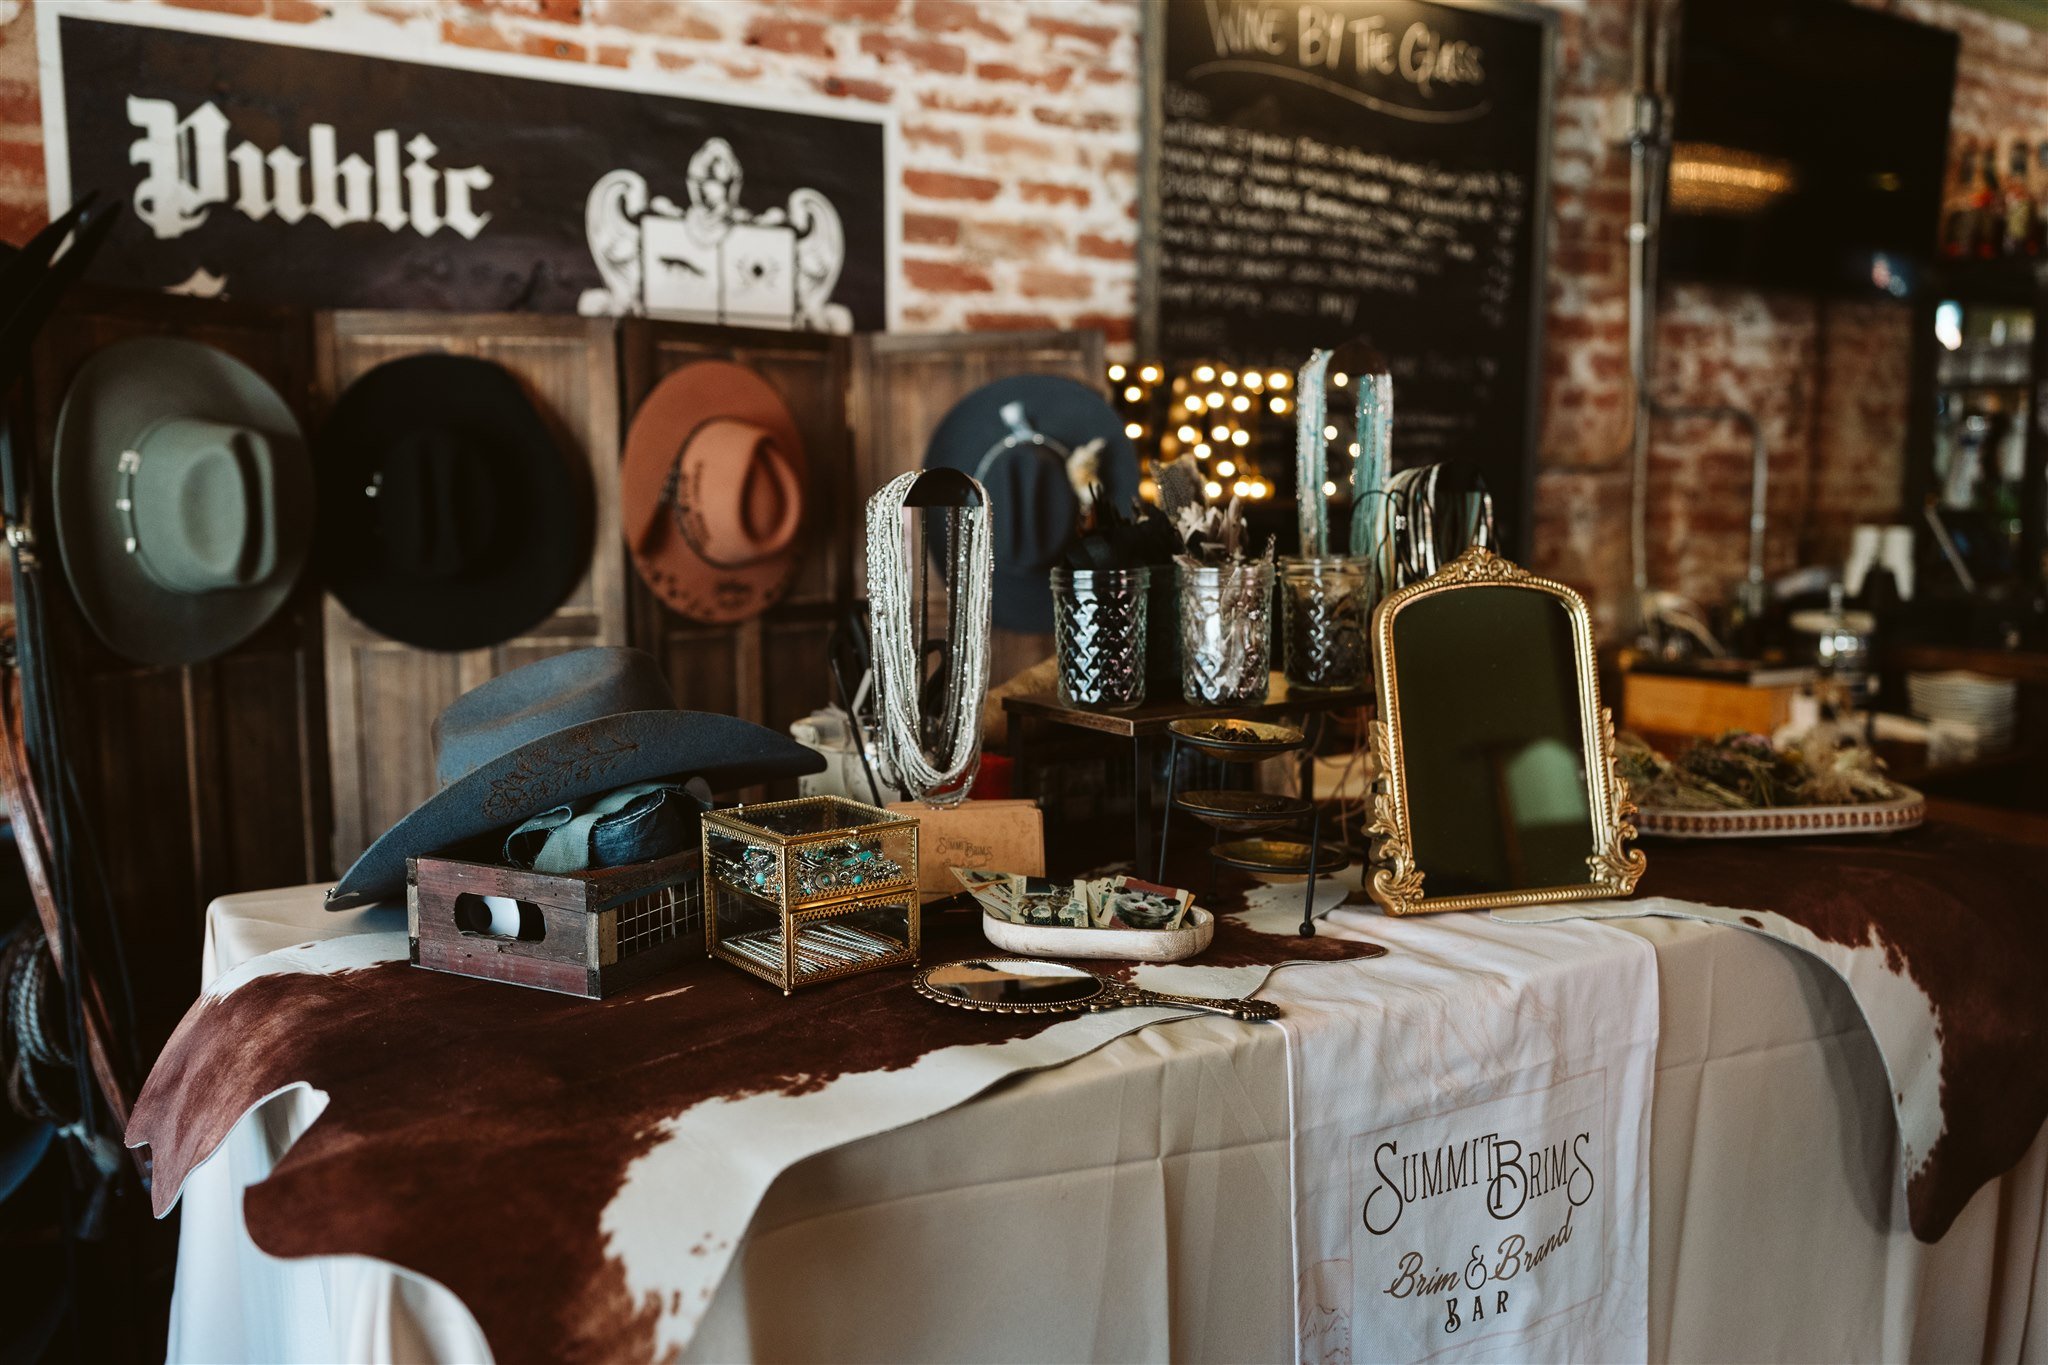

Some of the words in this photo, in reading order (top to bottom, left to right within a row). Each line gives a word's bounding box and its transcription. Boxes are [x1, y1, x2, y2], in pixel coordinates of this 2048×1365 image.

[1298, 5, 1345, 70] BY
[126, 94, 493, 240] Public
[1362, 1133, 1498, 1235] SUMMIT
[1486, 1132, 1594, 1220] BRIMS
[1383, 1251, 1461, 1299] Brim
[1464, 1245, 1487, 1290] &
[1487, 1206, 1574, 1281] Brand
[1444, 1290, 1509, 1333] BAR
